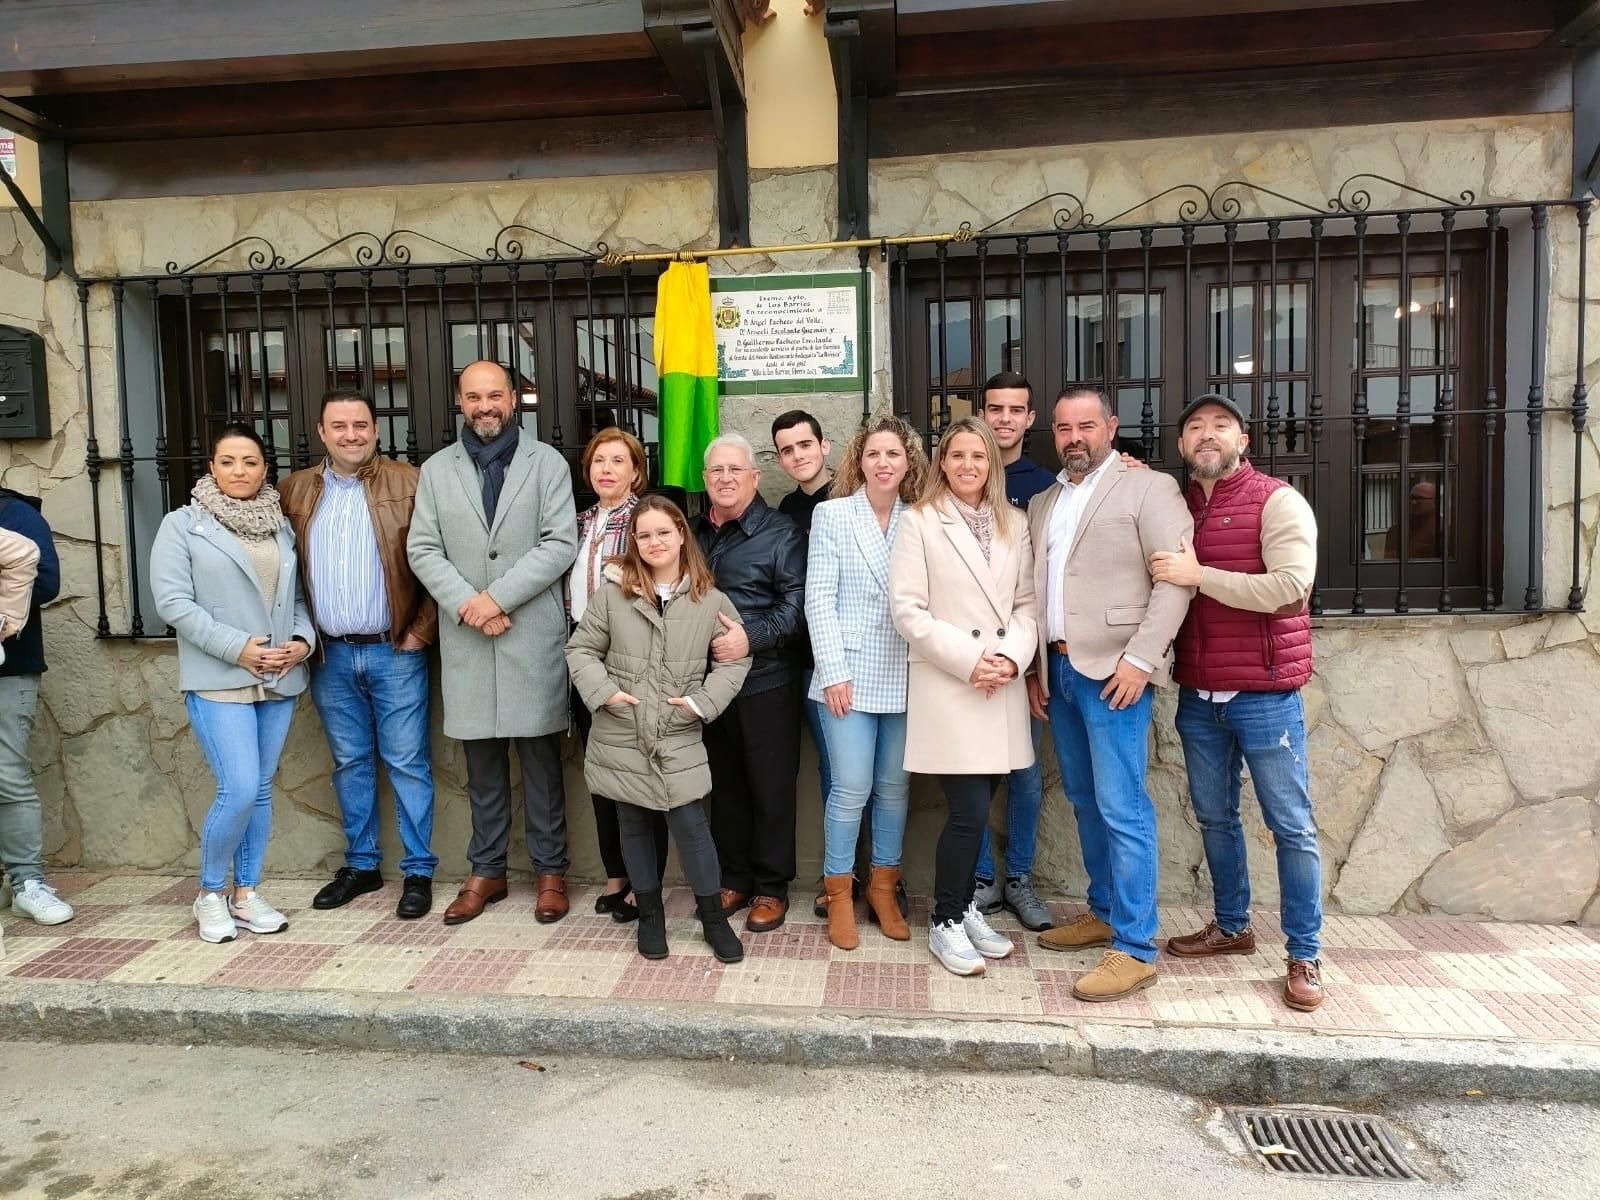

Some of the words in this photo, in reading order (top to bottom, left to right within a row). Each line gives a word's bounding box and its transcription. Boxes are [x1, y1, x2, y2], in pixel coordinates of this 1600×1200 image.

[757, 307, 815, 315] reconocimiento
[769, 318, 794, 326] Pacheco
[796, 317, 804, 325] del
[743, 338, 775, 348] Guillermo
